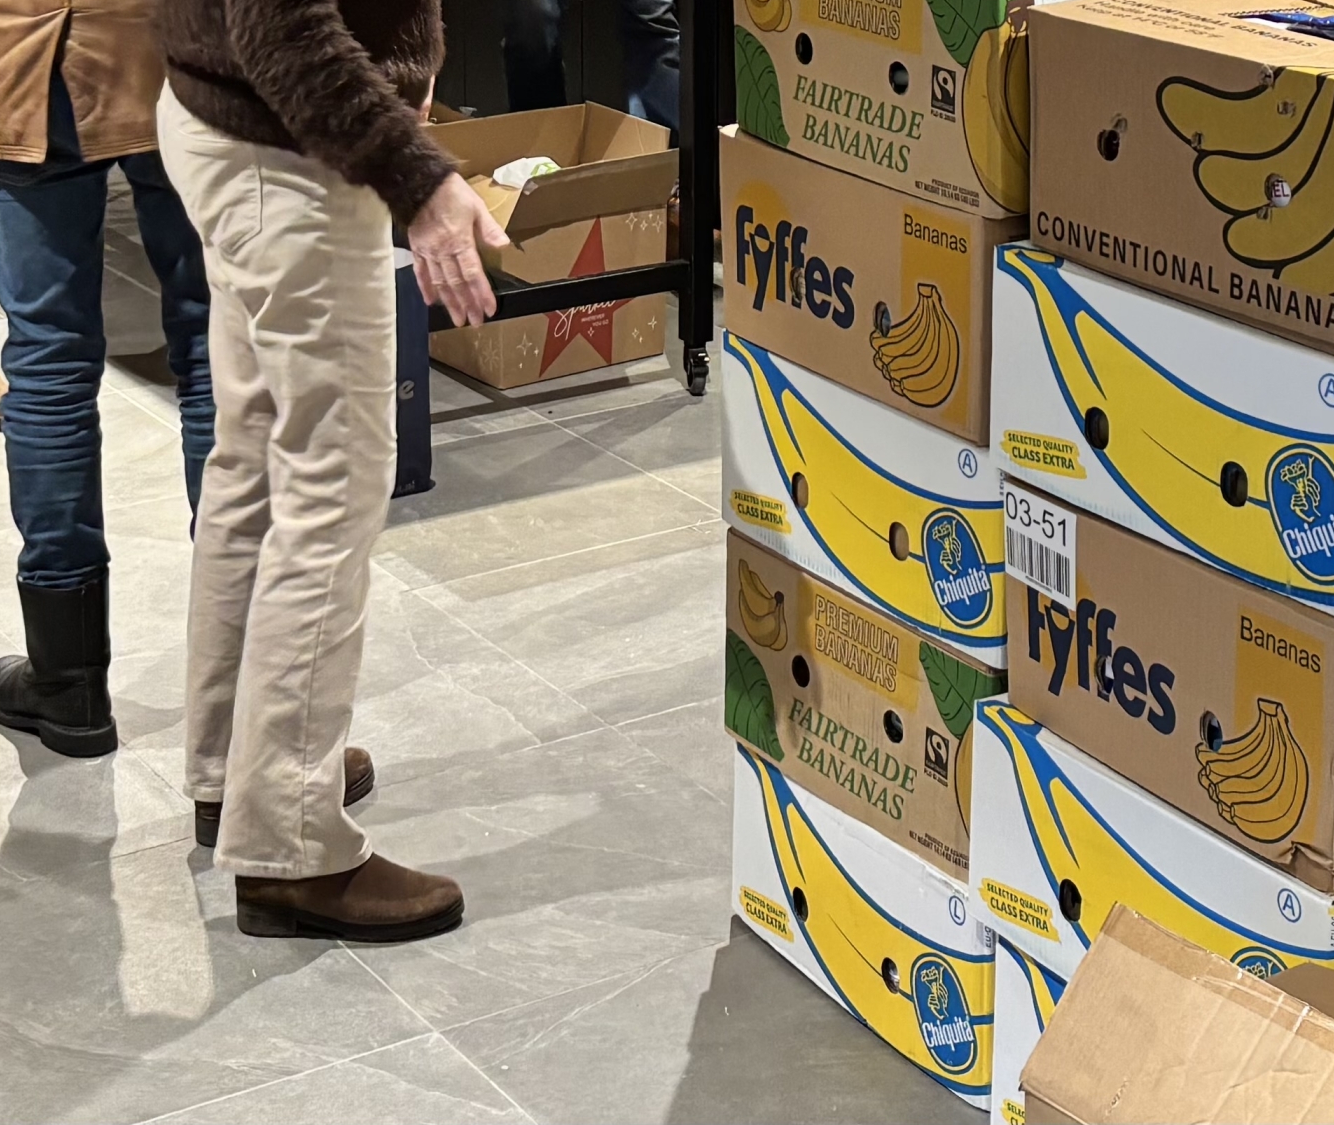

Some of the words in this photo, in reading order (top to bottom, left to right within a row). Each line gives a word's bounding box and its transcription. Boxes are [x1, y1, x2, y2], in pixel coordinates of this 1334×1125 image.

[1232, 24, 1317, 48] BANANAS
[792, 74, 925, 141] FAIRTRADE
[801, 113, 911, 173] BANANAS
[903, 213, 968, 255] Bananas
[1037, 211, 1220, 295] CONVENTIONAL
[1008, 432, 1042, 450] SELECTED
[1043, 439, 1074, 455] QUALITY
[1011, 446, 1042, 464] CLASS
[1043, 453, 1075, 471] EXTRA
[737, 504, 759, 521] CLASS
[761, 511, 784, 526] EXTRA
[1005, 492, 1067, 548] 03-51
[933, 567, 991, 607] Chiquita
[815, 595, 899, 664] PREMIUM
[1240, 616, 1322, 673] Bananas
[815, 625, 897, 693] BANANAS
[788, 701, 918, 795] FAIRTRADE
[797, 736, 904, 821] BANANAS
[745, 901, 766, 924] CLASS
[767, 915, 787, 935] EXTRA
[987, 882, 1018, 903] SELECTED
[1019, 897, 1049, 917] QUALITY
[990, 897, 1018, 921] CLASS
[1019, 912, 1050, 933] EXTRA
[1282, 894, 1297, 917] A
[922, 1018, 974, 1052] Chiquita
